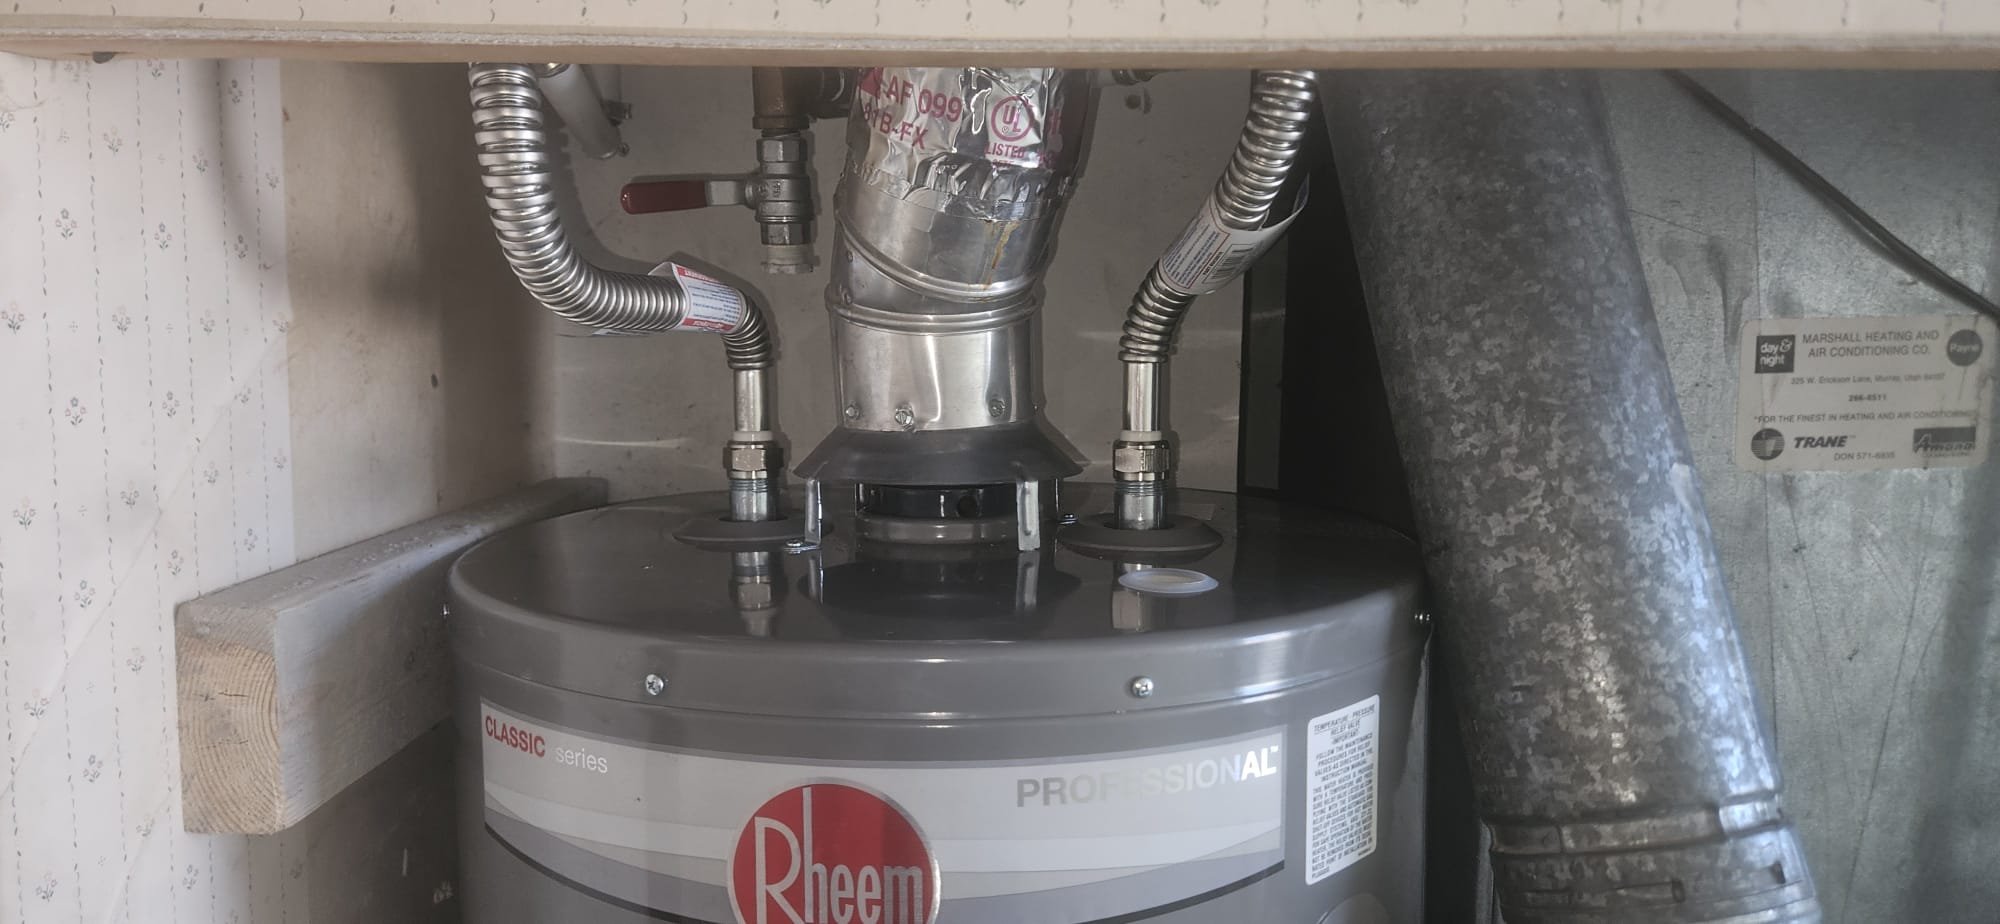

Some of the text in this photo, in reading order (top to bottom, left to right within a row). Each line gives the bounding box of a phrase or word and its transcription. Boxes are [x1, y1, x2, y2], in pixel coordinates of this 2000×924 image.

[918, 88, 962, 122] 099
[984, 142, 1026, 159] LISTED
[1802, 329, 1940, 344] MARSHALL HEATING AND
[1760, 341, 1779, 356] day
[1807, 347, 1827, 358] AIR
[1829, 344, 1910, 358] CONDITIONING
[1759, 354, 1785, 368] night
[1778, 414, 1795, 424] THE
[1796, 413, 1827, 423] FINEST
[1829, 412, 1838, 422] IN
[1839, 412, 1875, 422] HEATING
[1877, 411, 1896, 420] AND
[1897, 411, 1912, 420] AIR
[1794, 434, 1849, 449] TRANE
[1833, 452, 1855, 462] DON
[485, 715, 609, 774] CLASSIC series
[754, 786, 924, 924] Rheem
